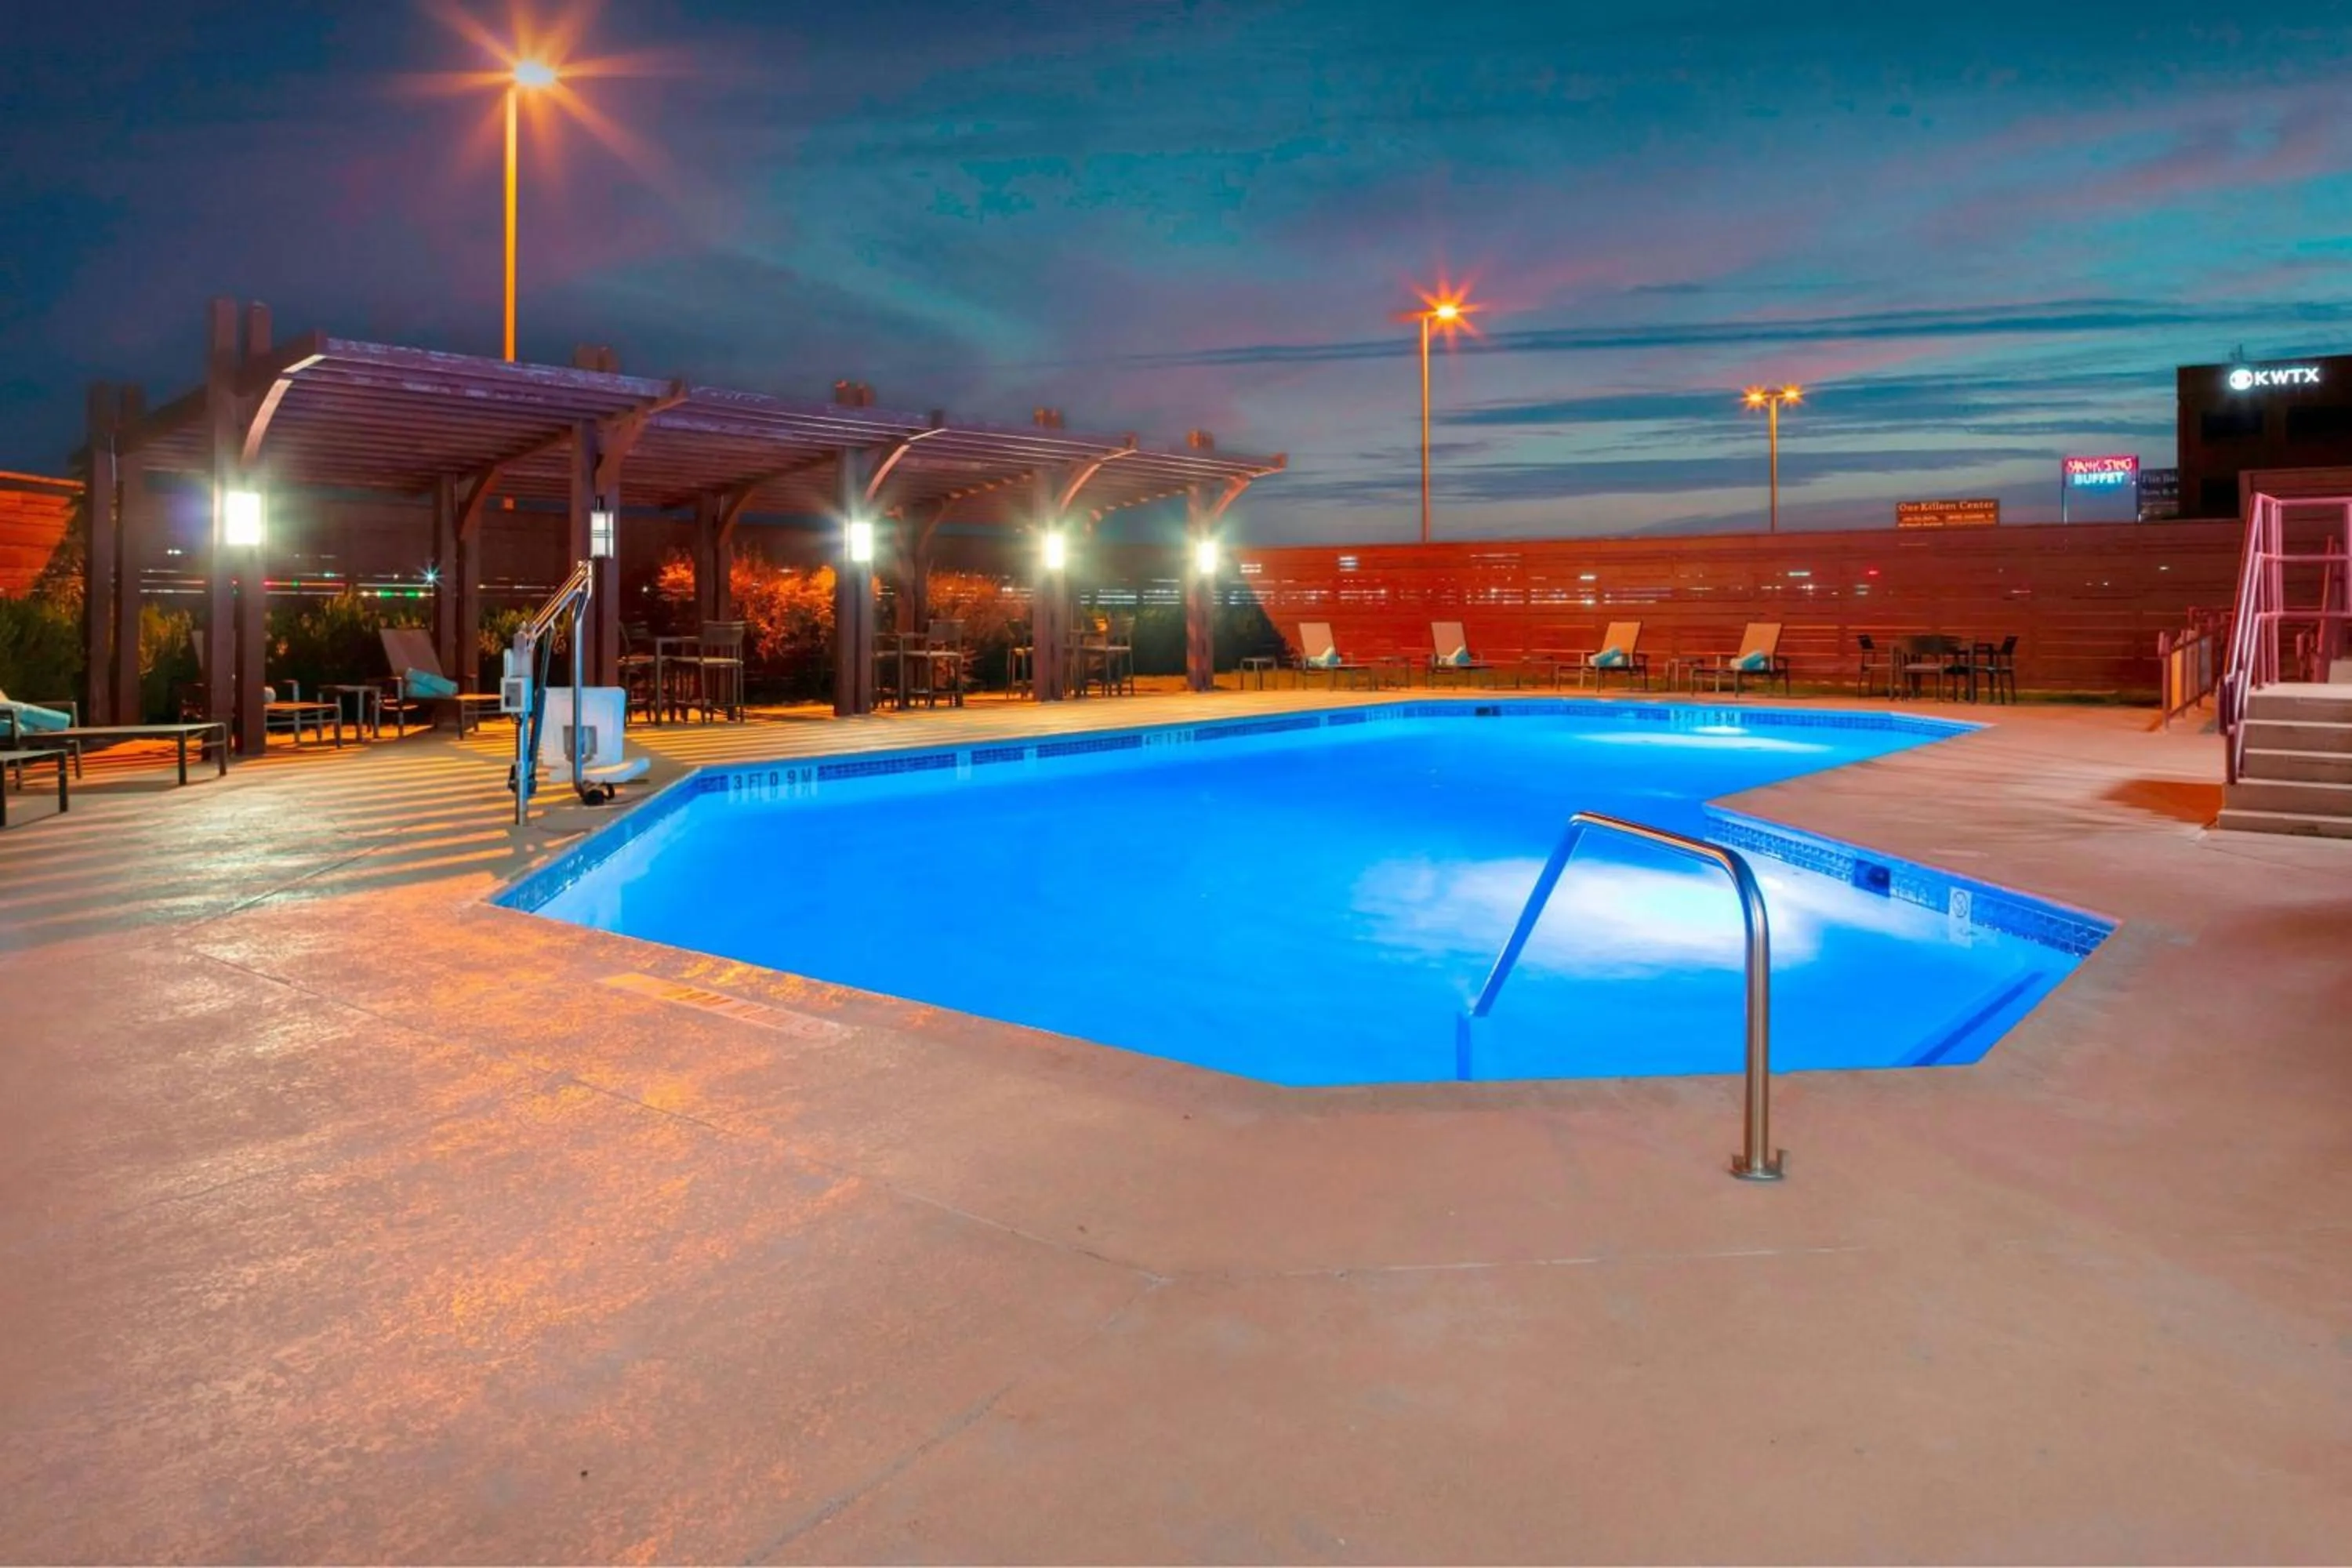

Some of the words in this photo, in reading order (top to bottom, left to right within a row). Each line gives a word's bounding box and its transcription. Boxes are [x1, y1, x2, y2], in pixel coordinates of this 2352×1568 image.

[2255, 368, 2319, 385] KWTX
[2074, 471, 2125, 485] BUFFET
[733, 775, 742, 789] 3
[749, 772, 764, 790] FT
[801, 768, 812, 782] M
